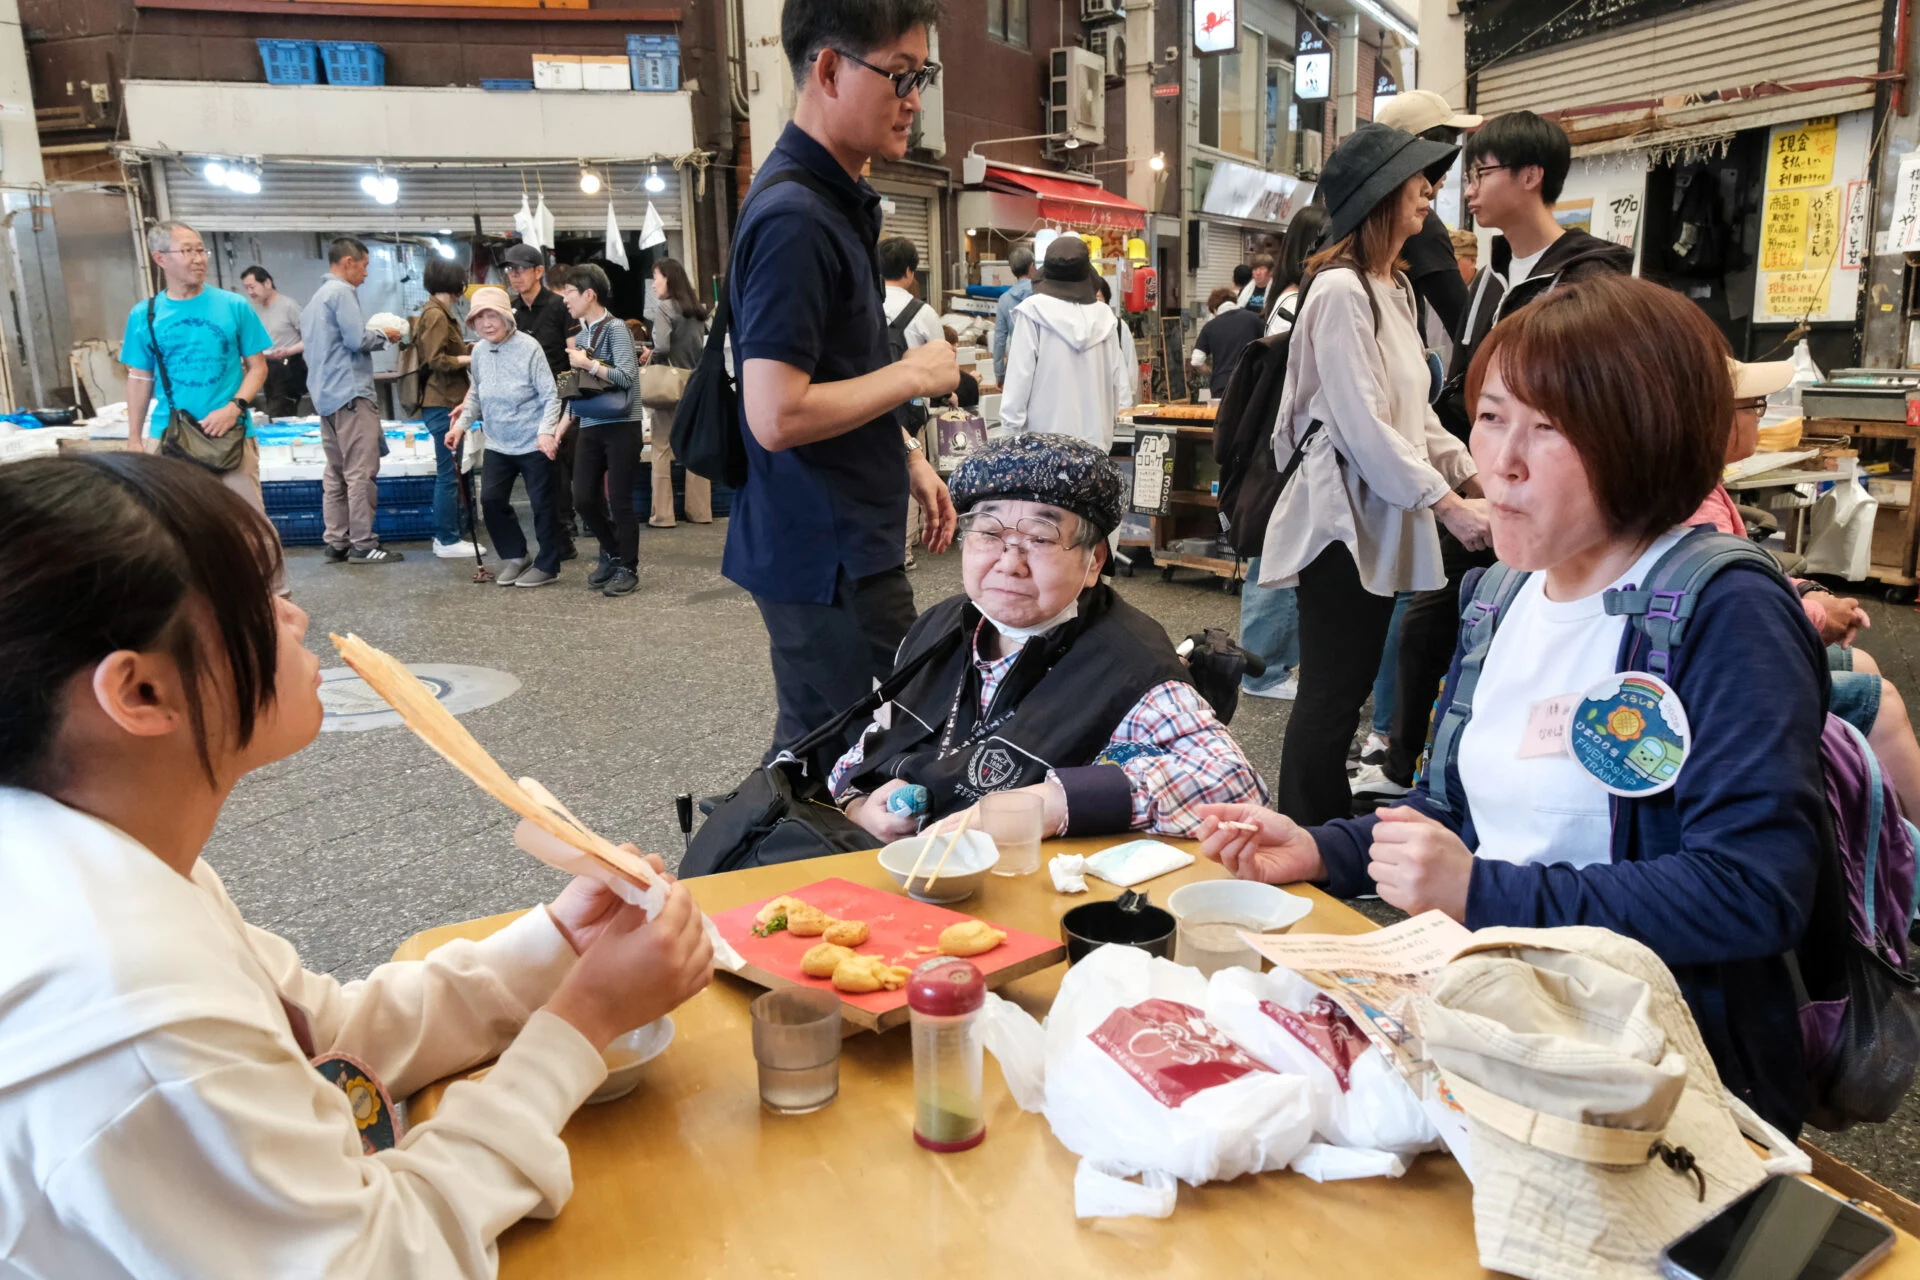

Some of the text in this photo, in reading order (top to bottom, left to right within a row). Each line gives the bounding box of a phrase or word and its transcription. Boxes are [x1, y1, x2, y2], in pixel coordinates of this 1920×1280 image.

[1777, 132, 1810, 154] 現金
[1609, 194, 1638, 214] マグロ
[1136, 454, 1162, 468] コロッケ
[991, 751, 1009, 766] SINCE
[1575, 737, 1637, 786] FRIENDSHIP
[1582, 755, 1619, 785] TRAIN
